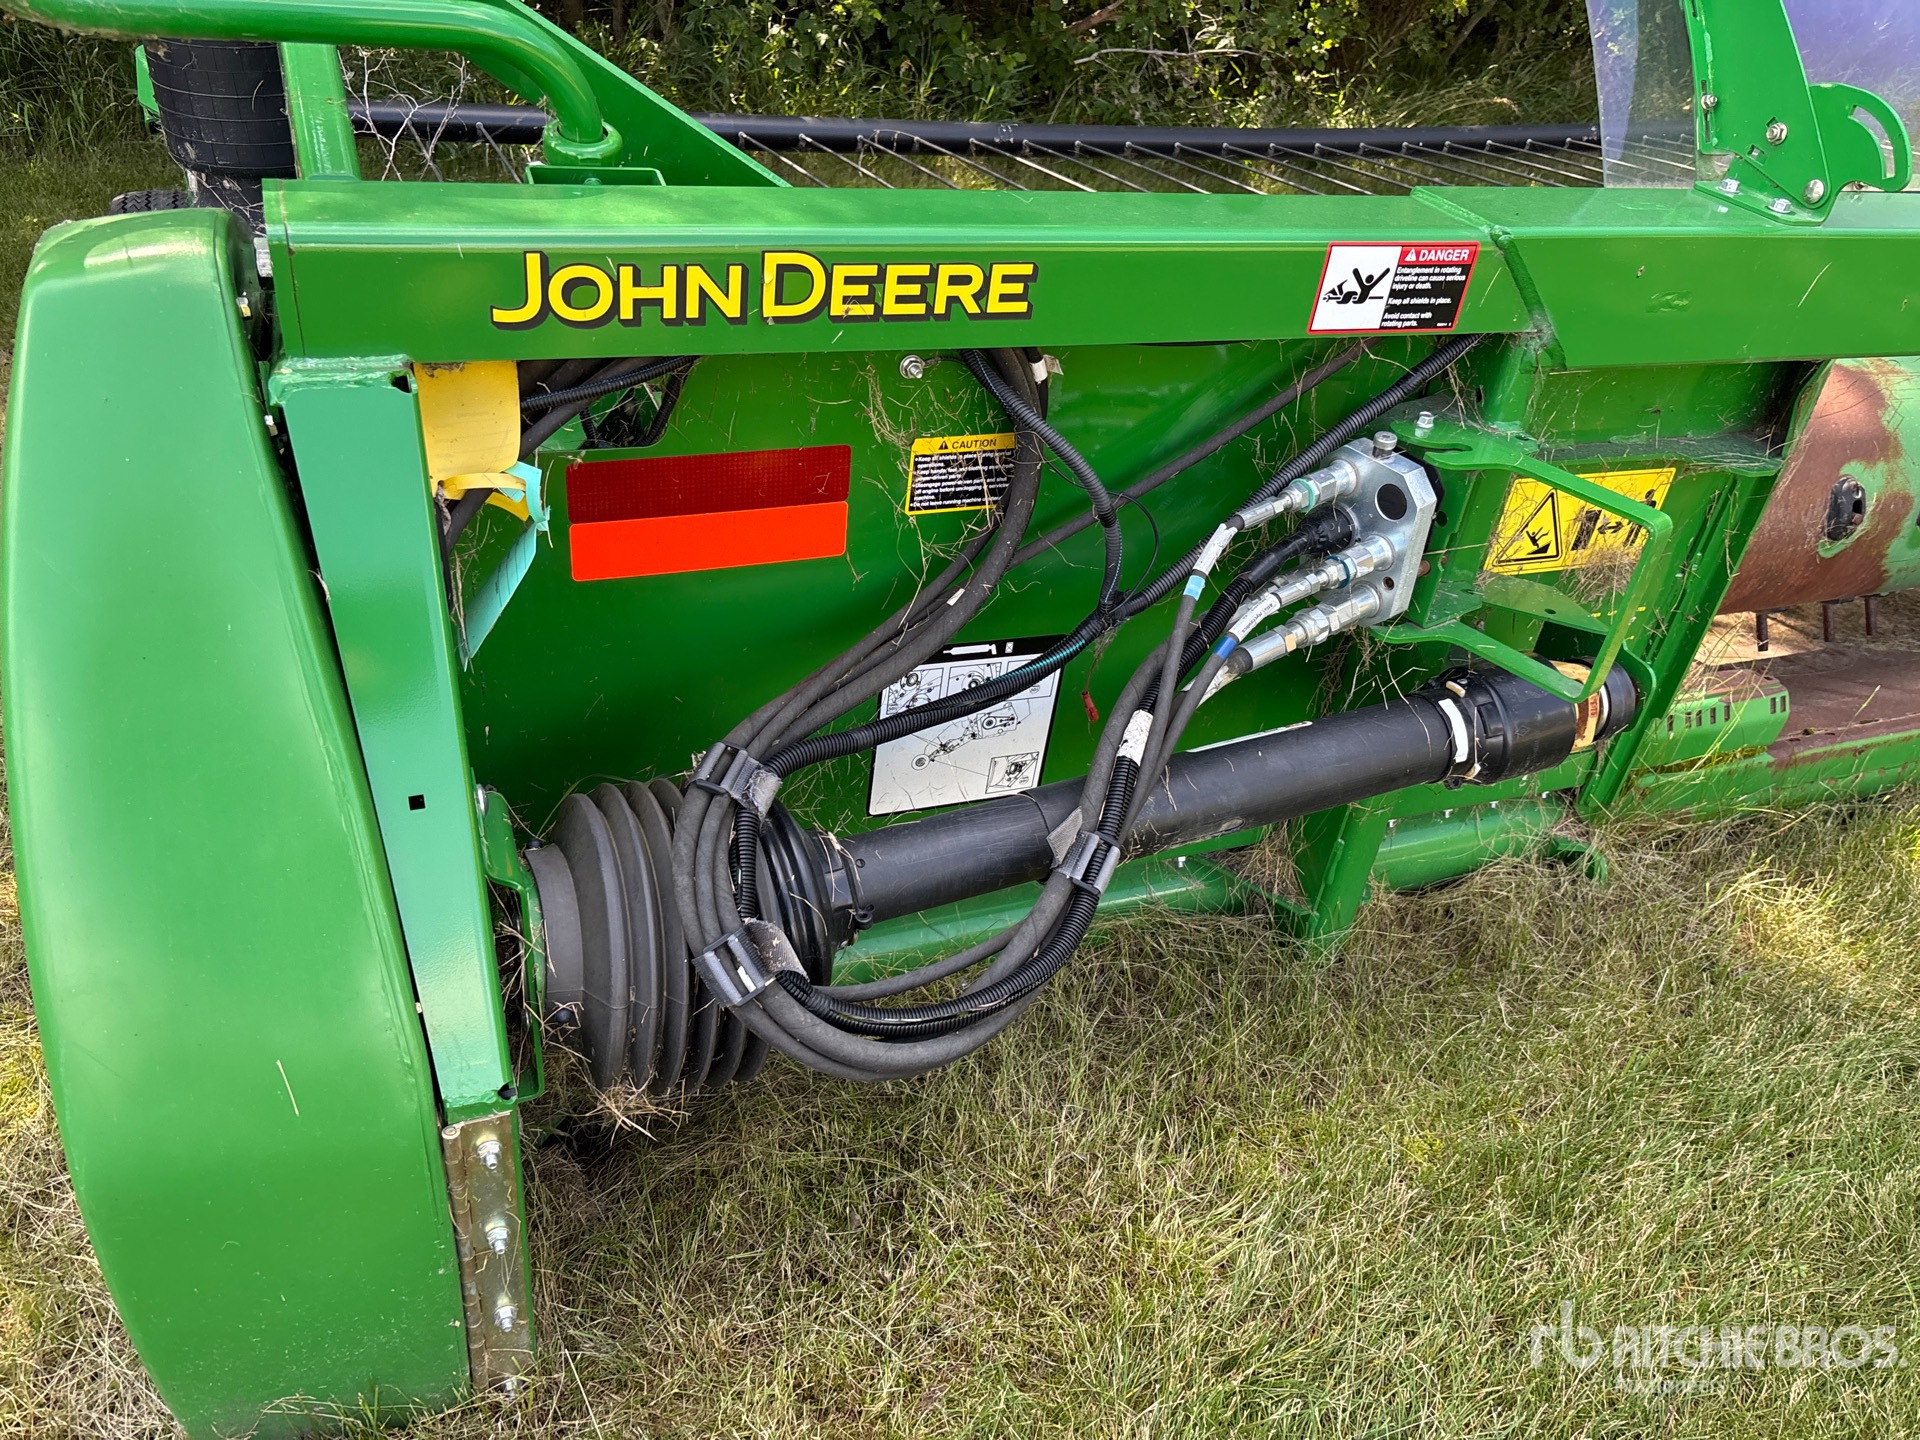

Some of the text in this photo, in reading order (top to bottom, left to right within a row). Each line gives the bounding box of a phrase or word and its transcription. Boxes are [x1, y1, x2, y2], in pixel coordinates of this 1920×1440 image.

[1418, 249, 1469, 262] DANGER
[1397, 266, 1434, 276] Entanglement
[1440, 266, 1462, 275] rotating
[1394, 274, 1418, 282] driveline
[490, 250, 1038, 330] JOHN DEERE
[1391, 282, 1408, 291] injury
[1415, 282, 1432, 290] death.
[1388, 297, 1402, 306] Keep
[1435, 296, 1452, 305] place.
[1381, 320, 1418, 328] rotating parts.
[952, 438, 997, 450] CAUTION
